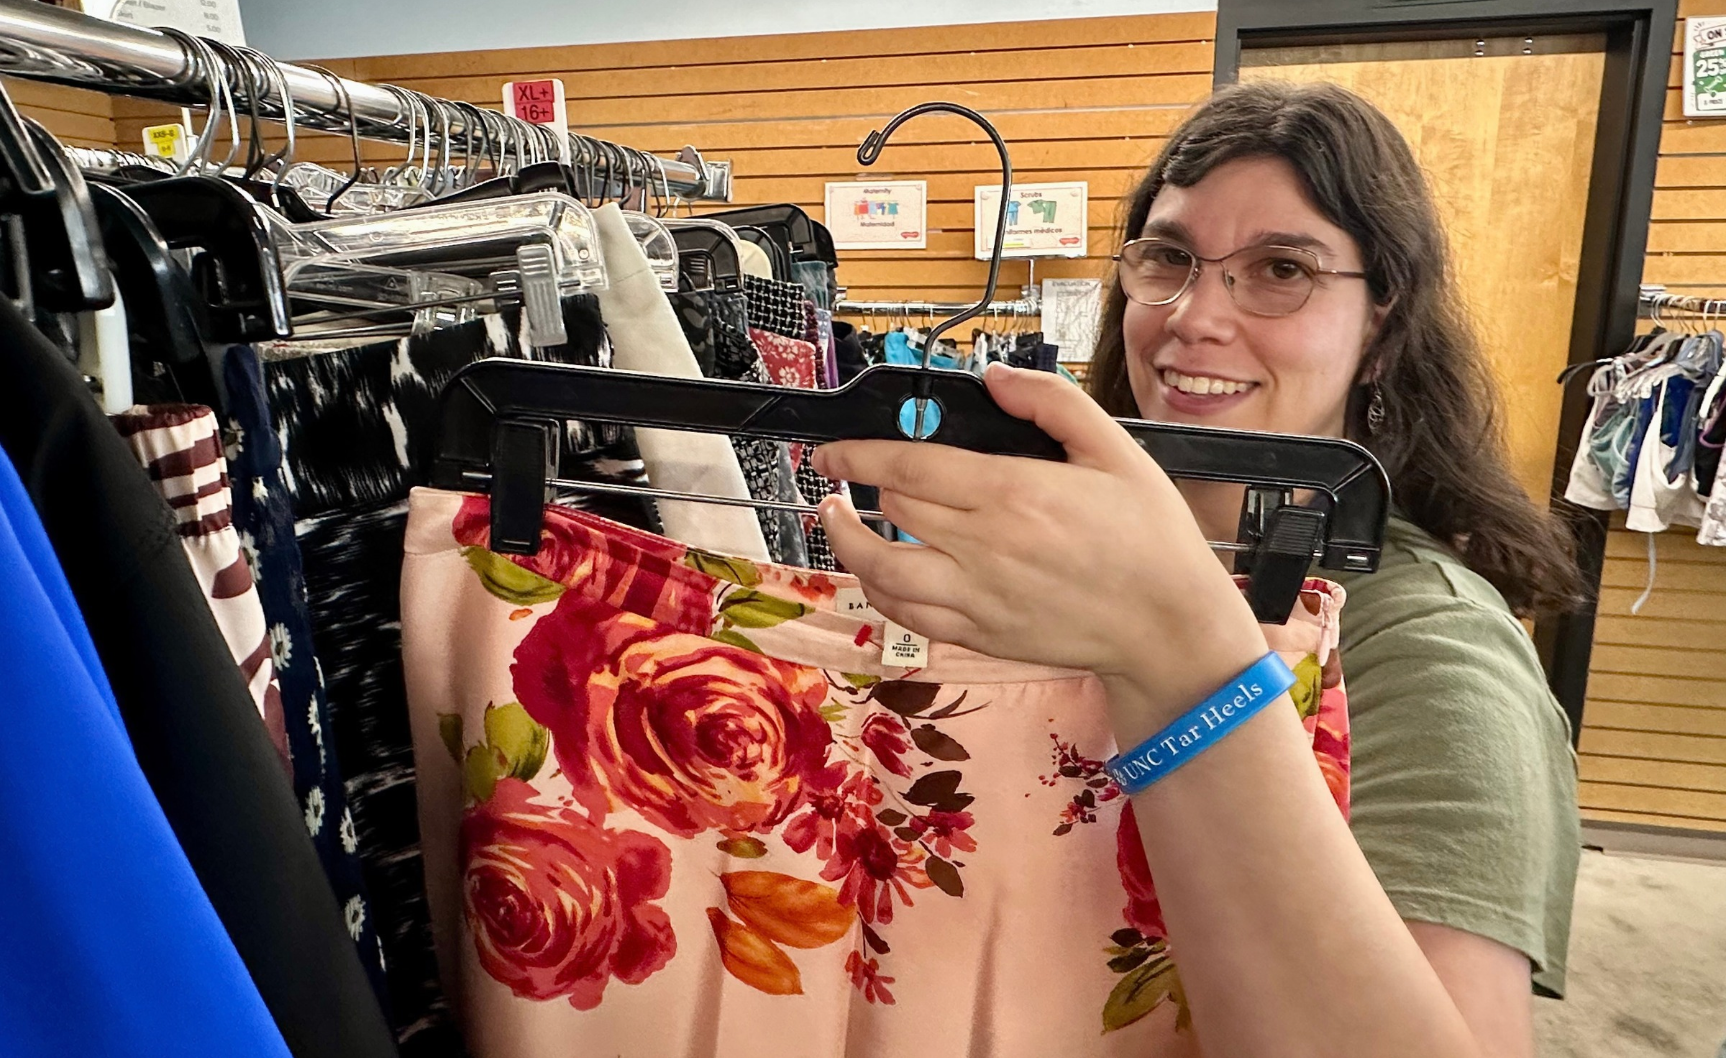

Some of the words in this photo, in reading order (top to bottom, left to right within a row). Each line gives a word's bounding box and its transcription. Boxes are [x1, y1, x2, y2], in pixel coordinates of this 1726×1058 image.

[1707, 28, 1722, 40] ON
[518, 85, 549, 101] XL+
[521, 104, 549, 120] 16+
[903, 634, 911, 642] 0
[1123, 748, 1163, 781] UNC
[1160, 725, 1202, 756] Tar
[1200, 682, 1263, 730] Heels
